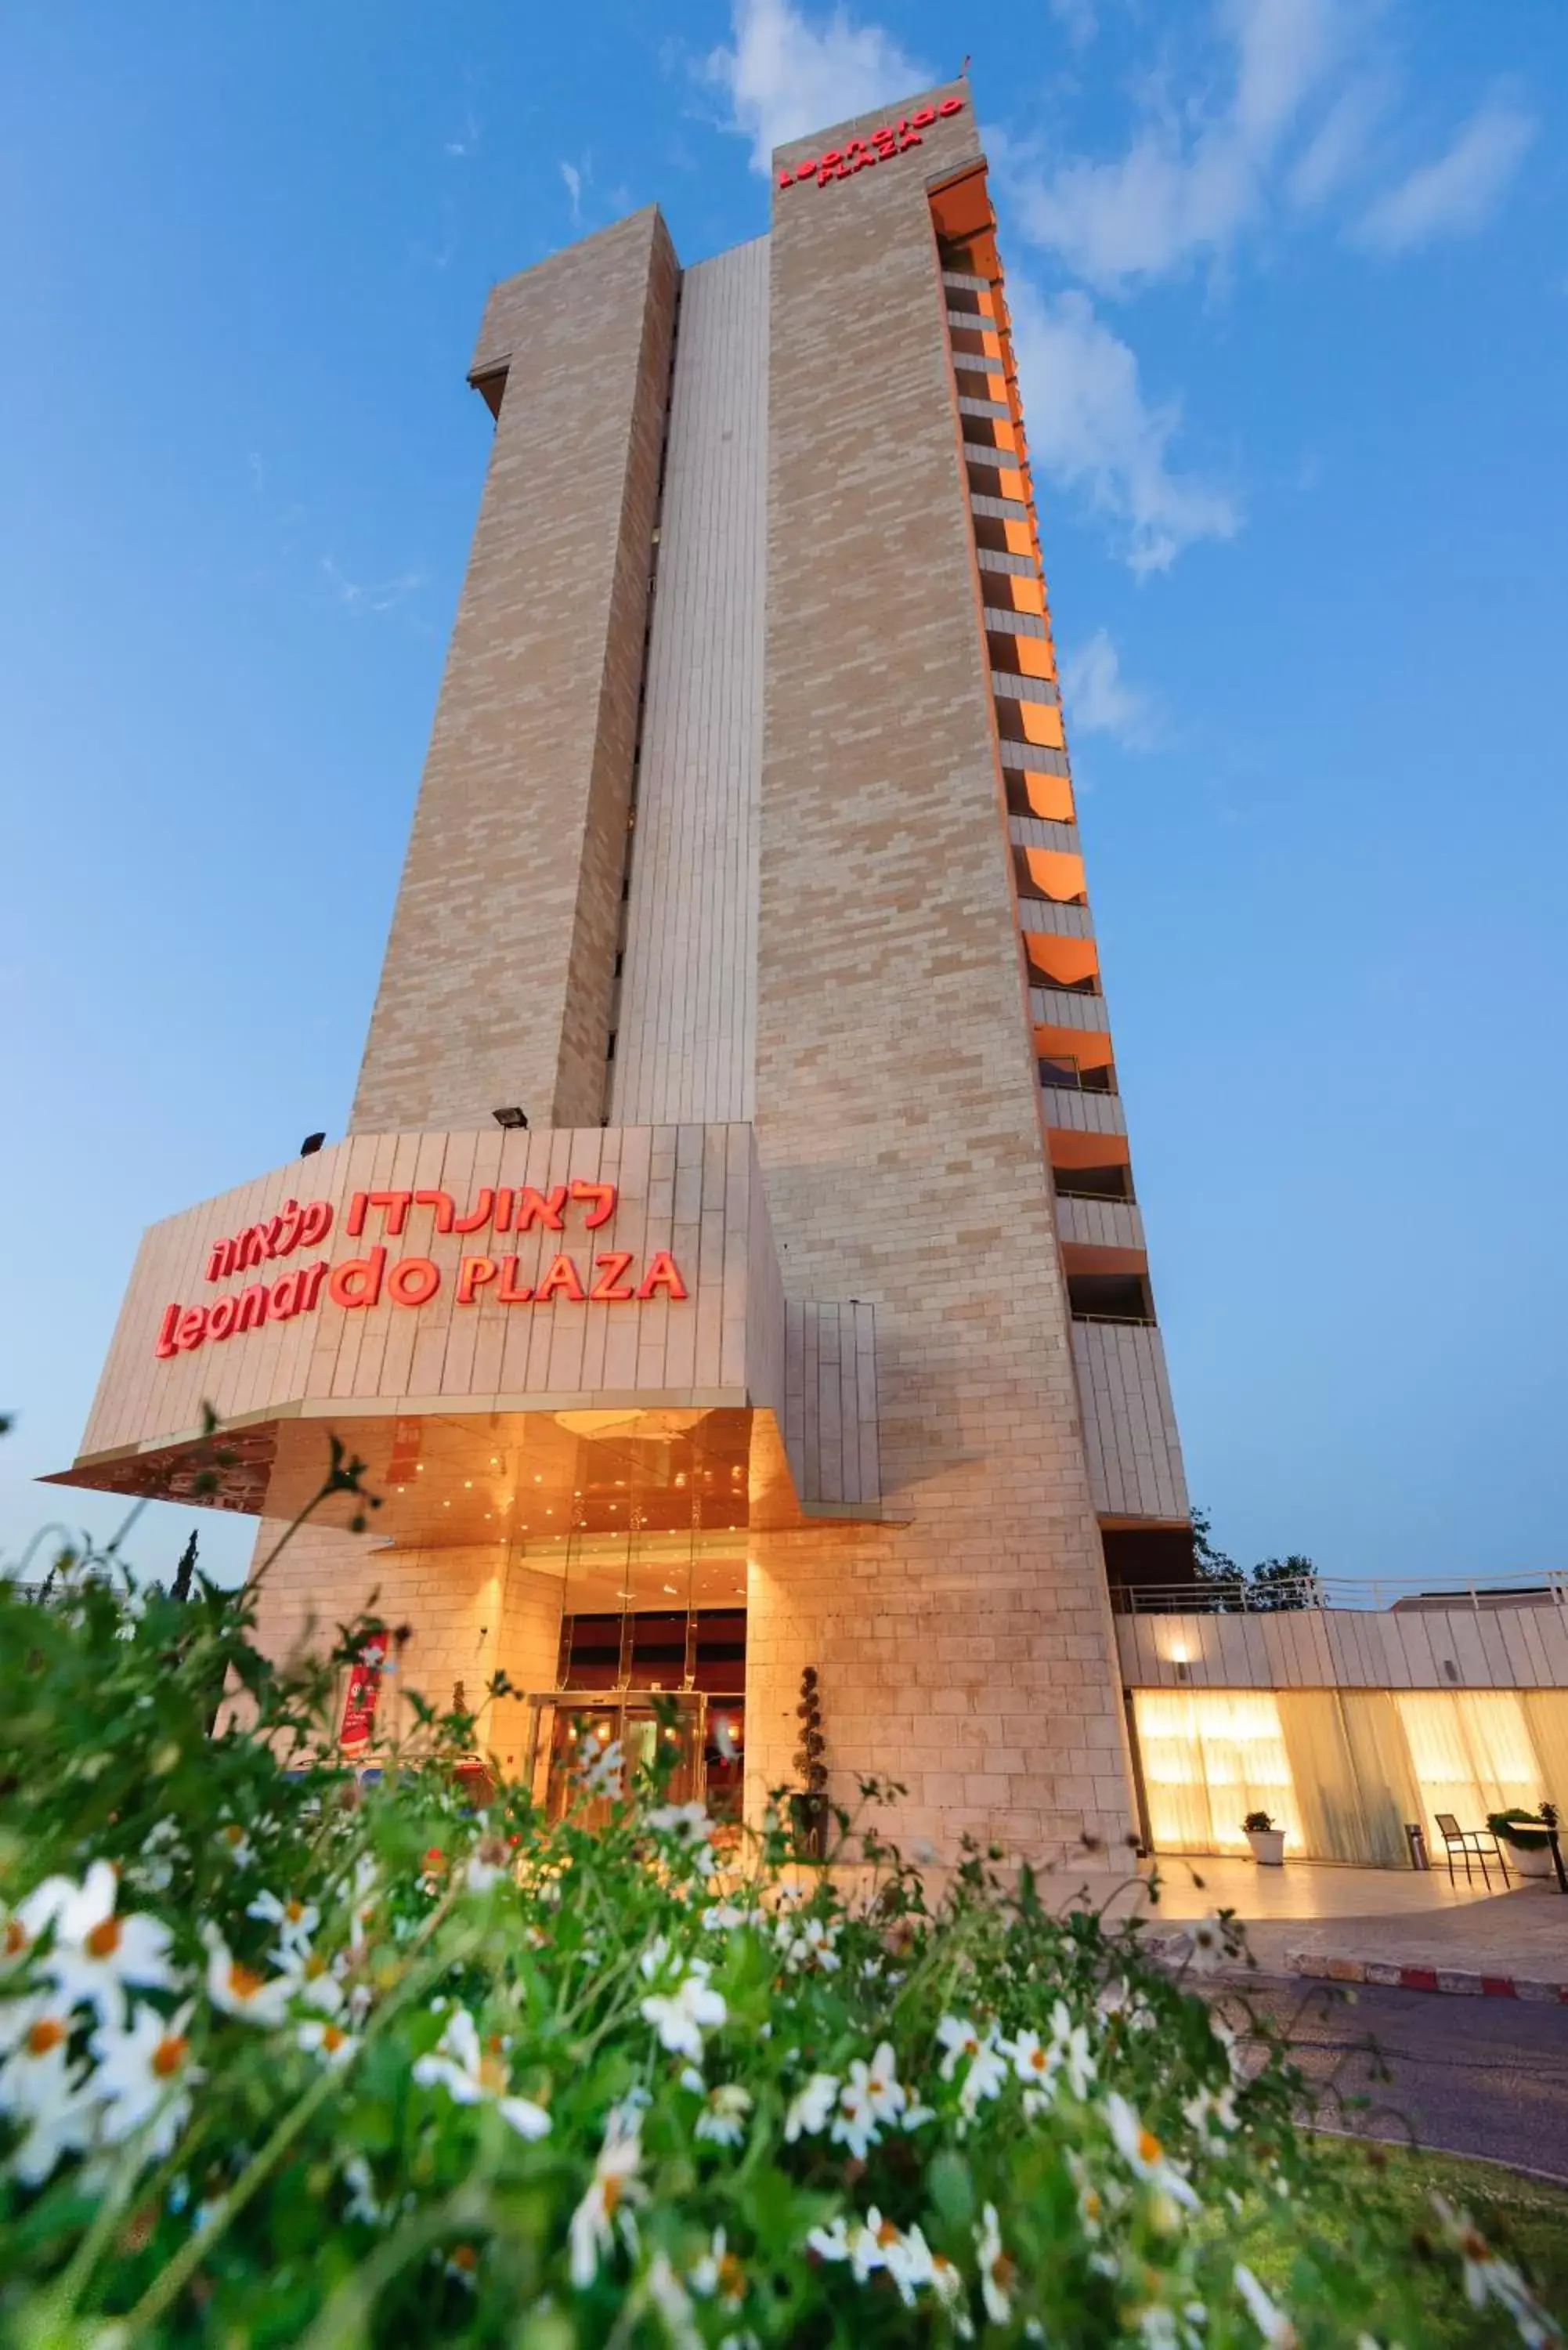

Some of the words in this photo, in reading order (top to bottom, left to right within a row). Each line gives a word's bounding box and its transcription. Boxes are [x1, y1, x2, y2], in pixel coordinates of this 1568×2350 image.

[779, 96, 963, 188] Leonardo
[818, 131, 923, 188] PLAZA
[345, 1180, 620, 1236] לאונרדו
[204, 1199, 334, 1282] פלאזה
[457, 1252, 688, 1303] PLAZA
